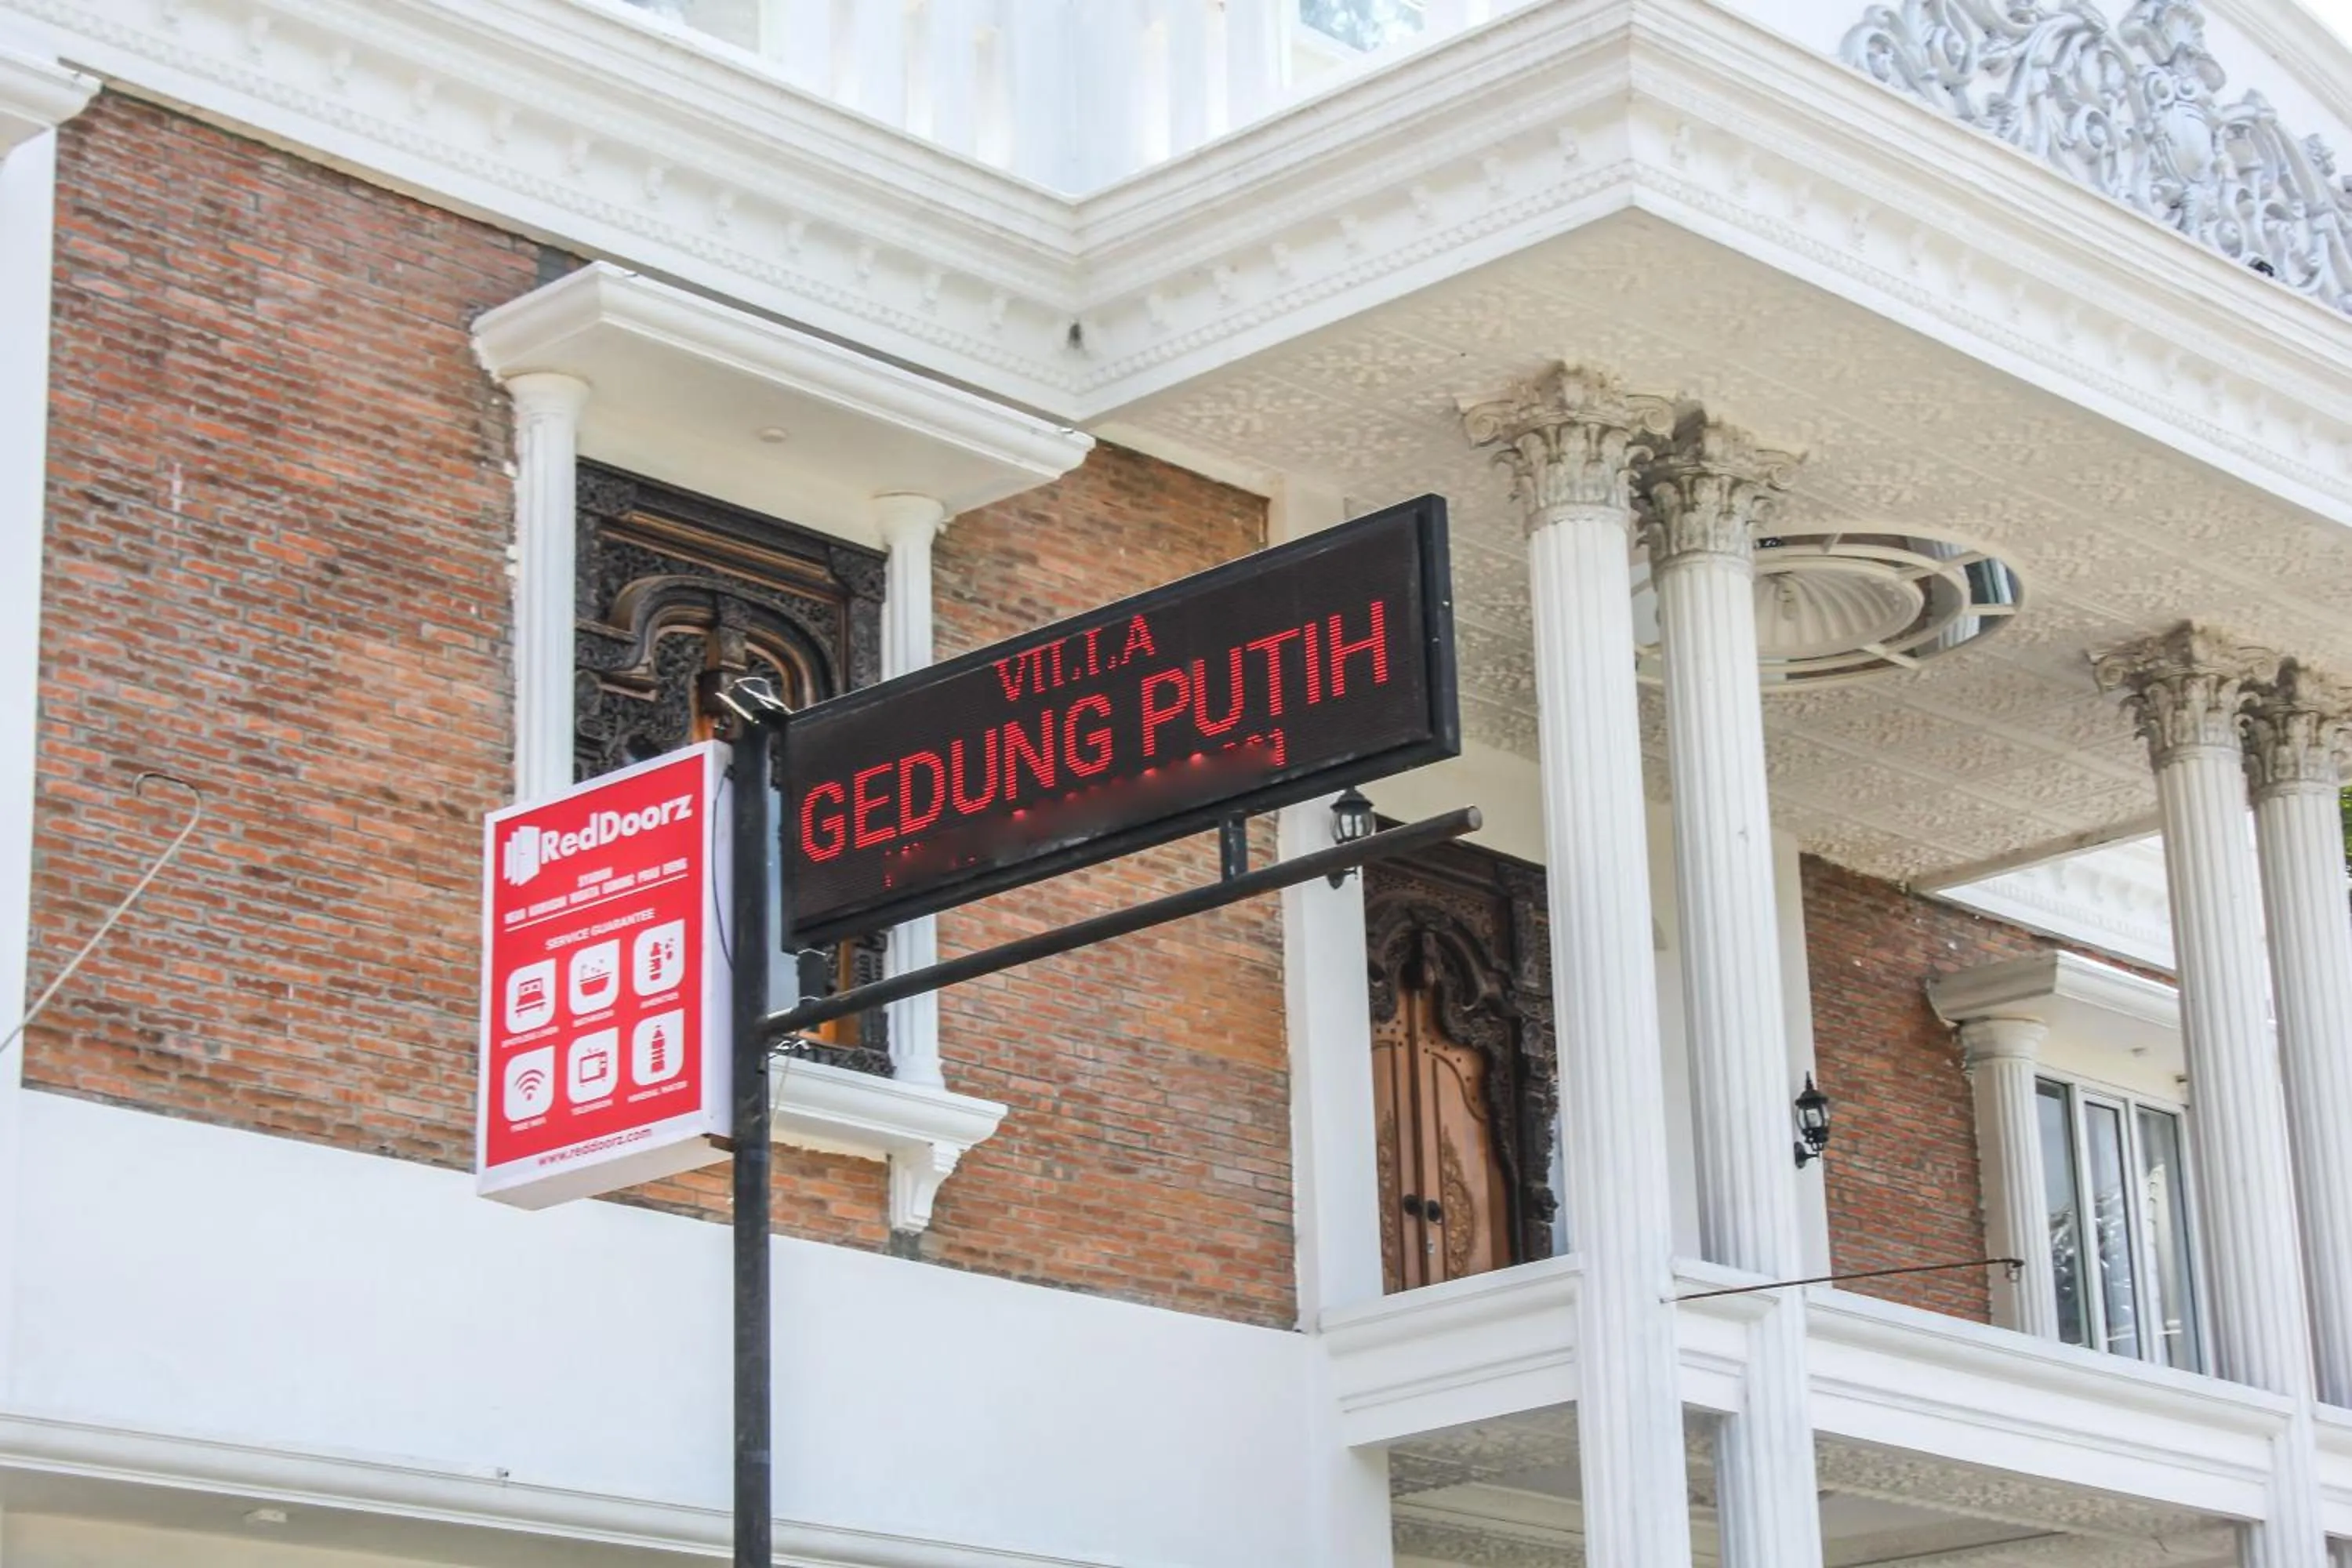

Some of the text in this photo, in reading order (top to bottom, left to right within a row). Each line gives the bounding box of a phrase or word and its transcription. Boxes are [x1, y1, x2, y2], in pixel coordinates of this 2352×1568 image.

[801, 694, 1113, 862] GEDUNG
[1142, 601, 1388, 757] PUTIH
[540, 793, 693, 864] RedDoorz
[545, 908, 656, 951] SERVICE GUARANTEE
[538, 1128, 652, 1167] www.reddoorz.com
